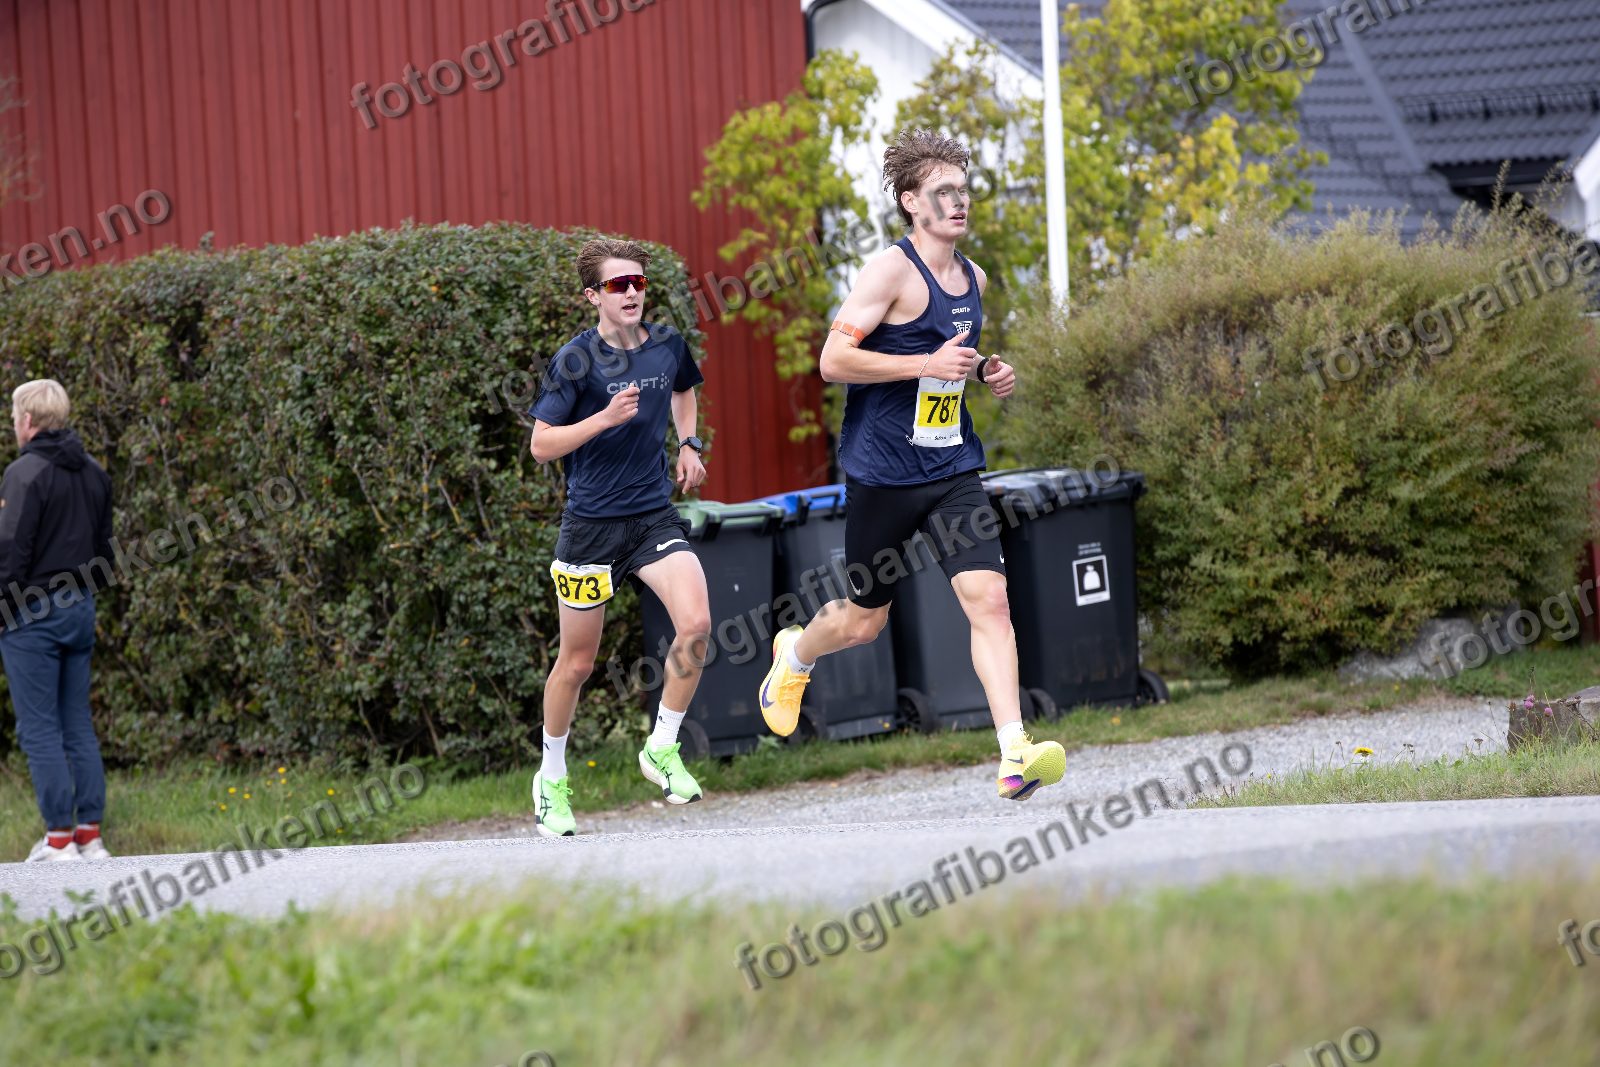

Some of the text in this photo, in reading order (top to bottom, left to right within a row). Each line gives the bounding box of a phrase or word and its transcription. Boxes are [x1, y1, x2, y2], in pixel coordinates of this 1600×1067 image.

[606, 376, 659, 395] CRAFT
[926, 394, 960, 424] 787
[557, 573, 602, 601] 873
